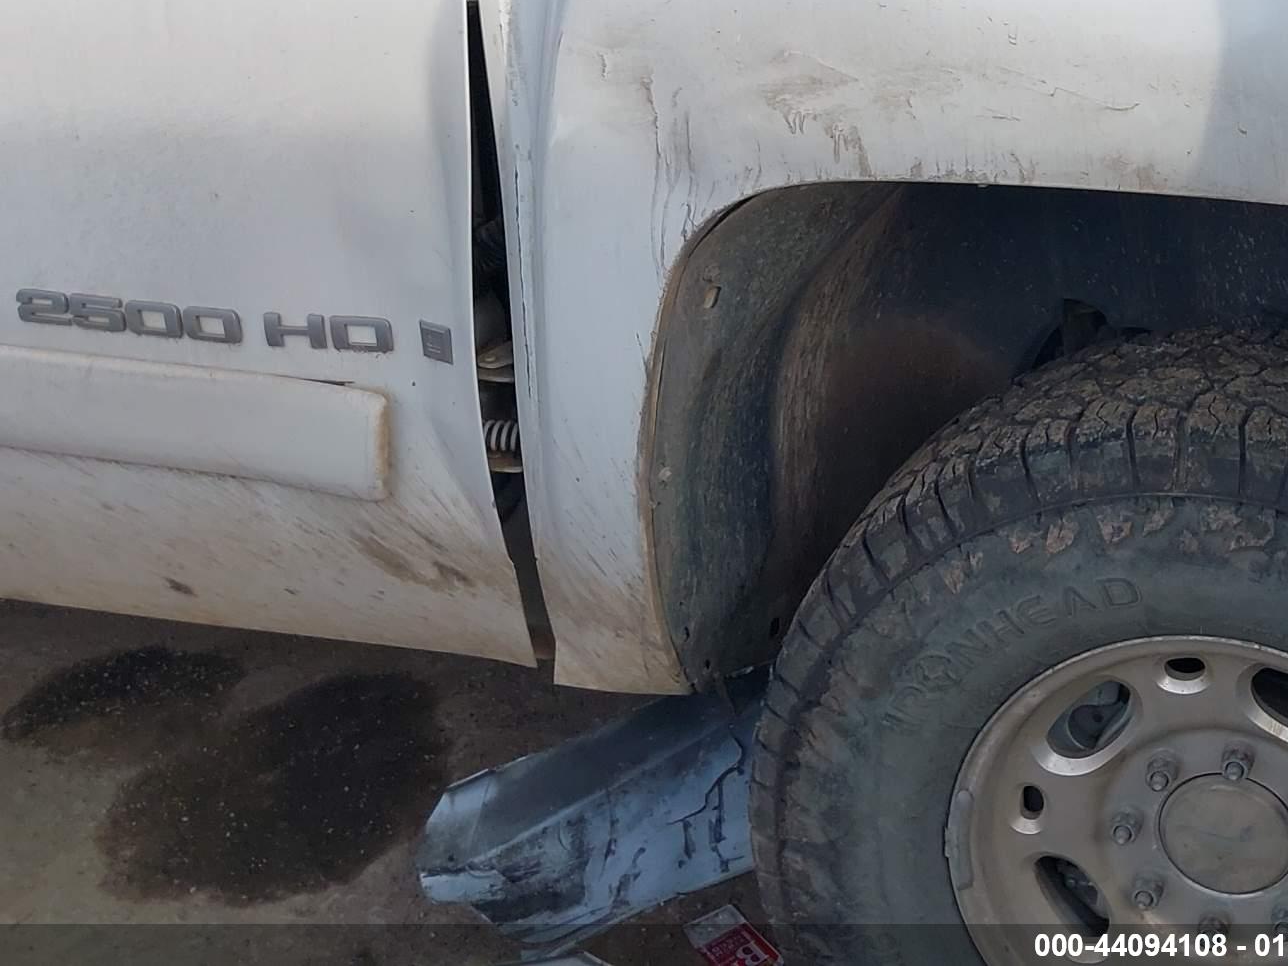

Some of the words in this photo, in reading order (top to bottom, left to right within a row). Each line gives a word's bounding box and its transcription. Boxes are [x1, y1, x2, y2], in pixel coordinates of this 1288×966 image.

[16, 288, 244, 344] 2500
[263, 312, 395, 352] HD
[880, 576, 1143, 728] IRONHEAD
